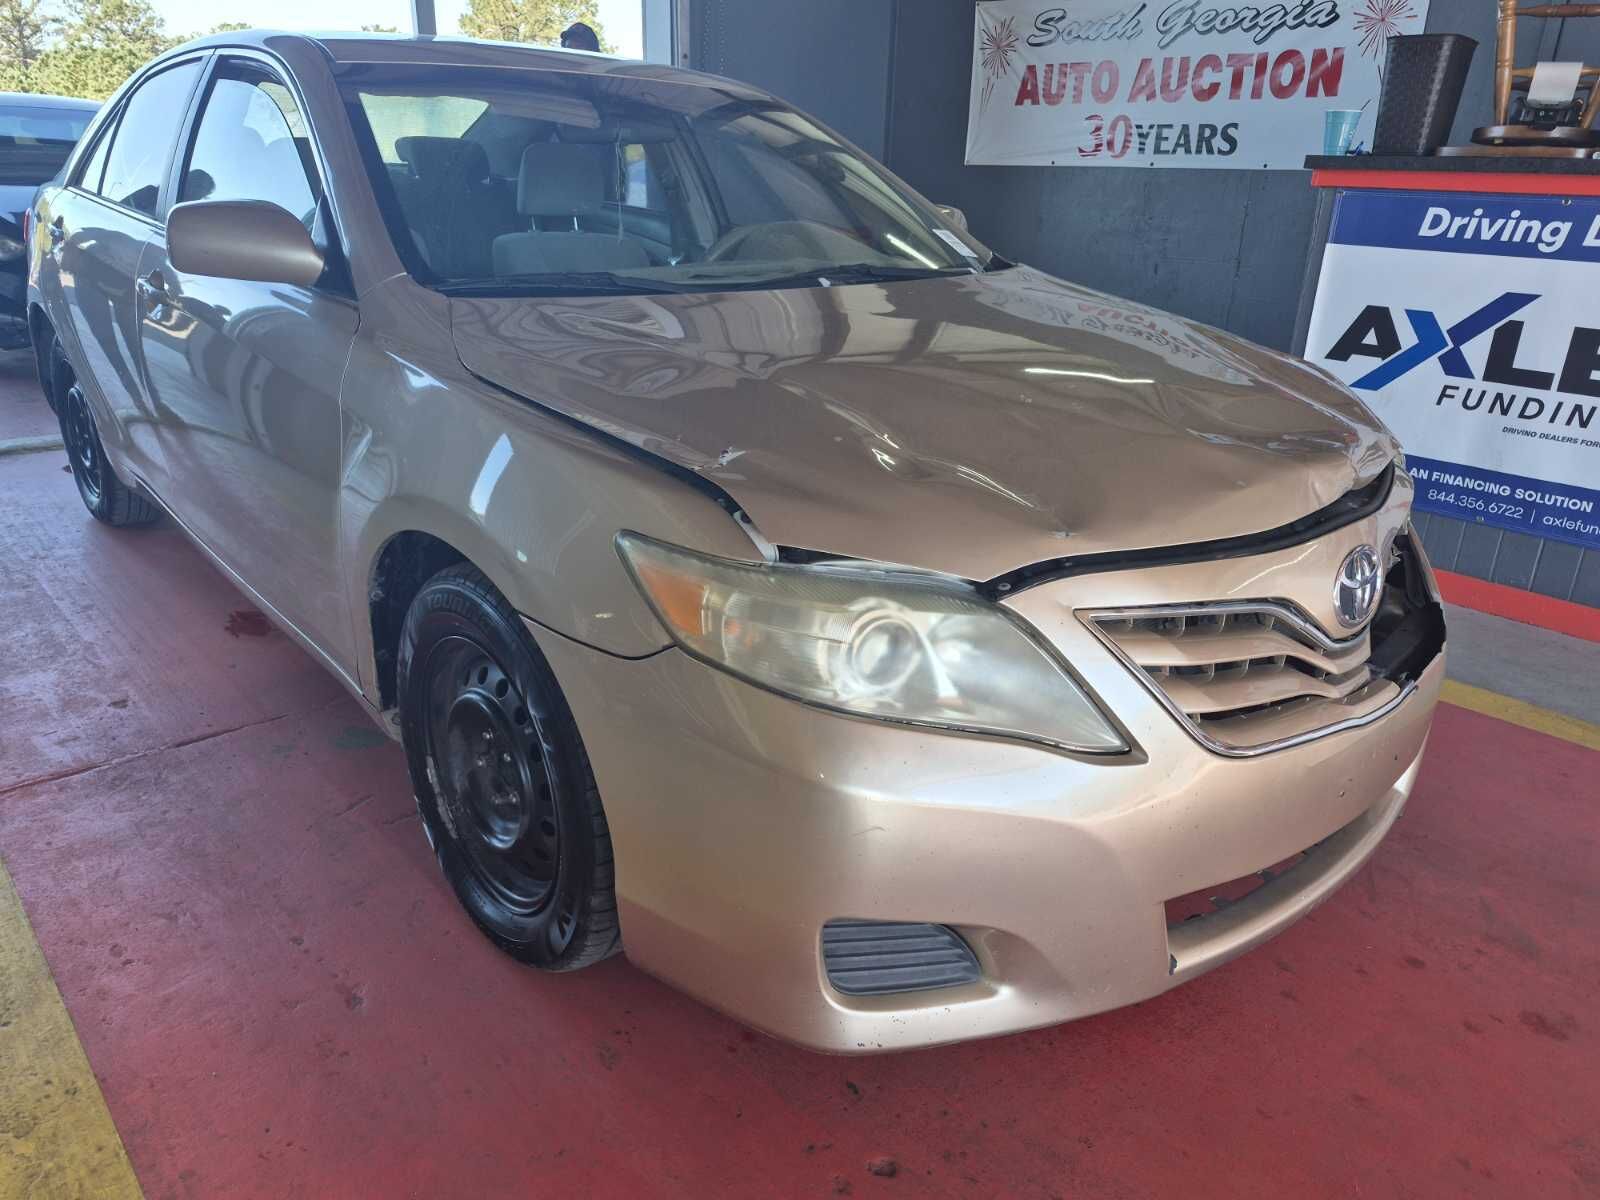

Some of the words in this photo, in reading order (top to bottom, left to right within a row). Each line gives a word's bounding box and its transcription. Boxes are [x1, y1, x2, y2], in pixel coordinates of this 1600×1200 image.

[1027, 2, 1147, 47] South
[1156, 0, 1341, 49] Georgia
[1014, 59, 1120, 107] AUTO
[1128, 47, 1345, 105] AUCTION
[1077, 114, 1133, 159] 30
[1134, 122, 1239, 156] YEARS
[1418, 206, 1573, 253] Driving
[1435, 384, 1598, 429] FUNDIN
[1502, 426, 1537, 438] DRIVING
[1539, 432, 1578, 444] DEALERS
[1580, 439, 1600, 449] FOR
[1428, 488, 1524, 519] 844.356.6722
[1542, 514, 1600, 536] axlefun
[1431, 472, 1511, 496] FINANCING
[1514, 488, 1594, 513] SOLUTION
